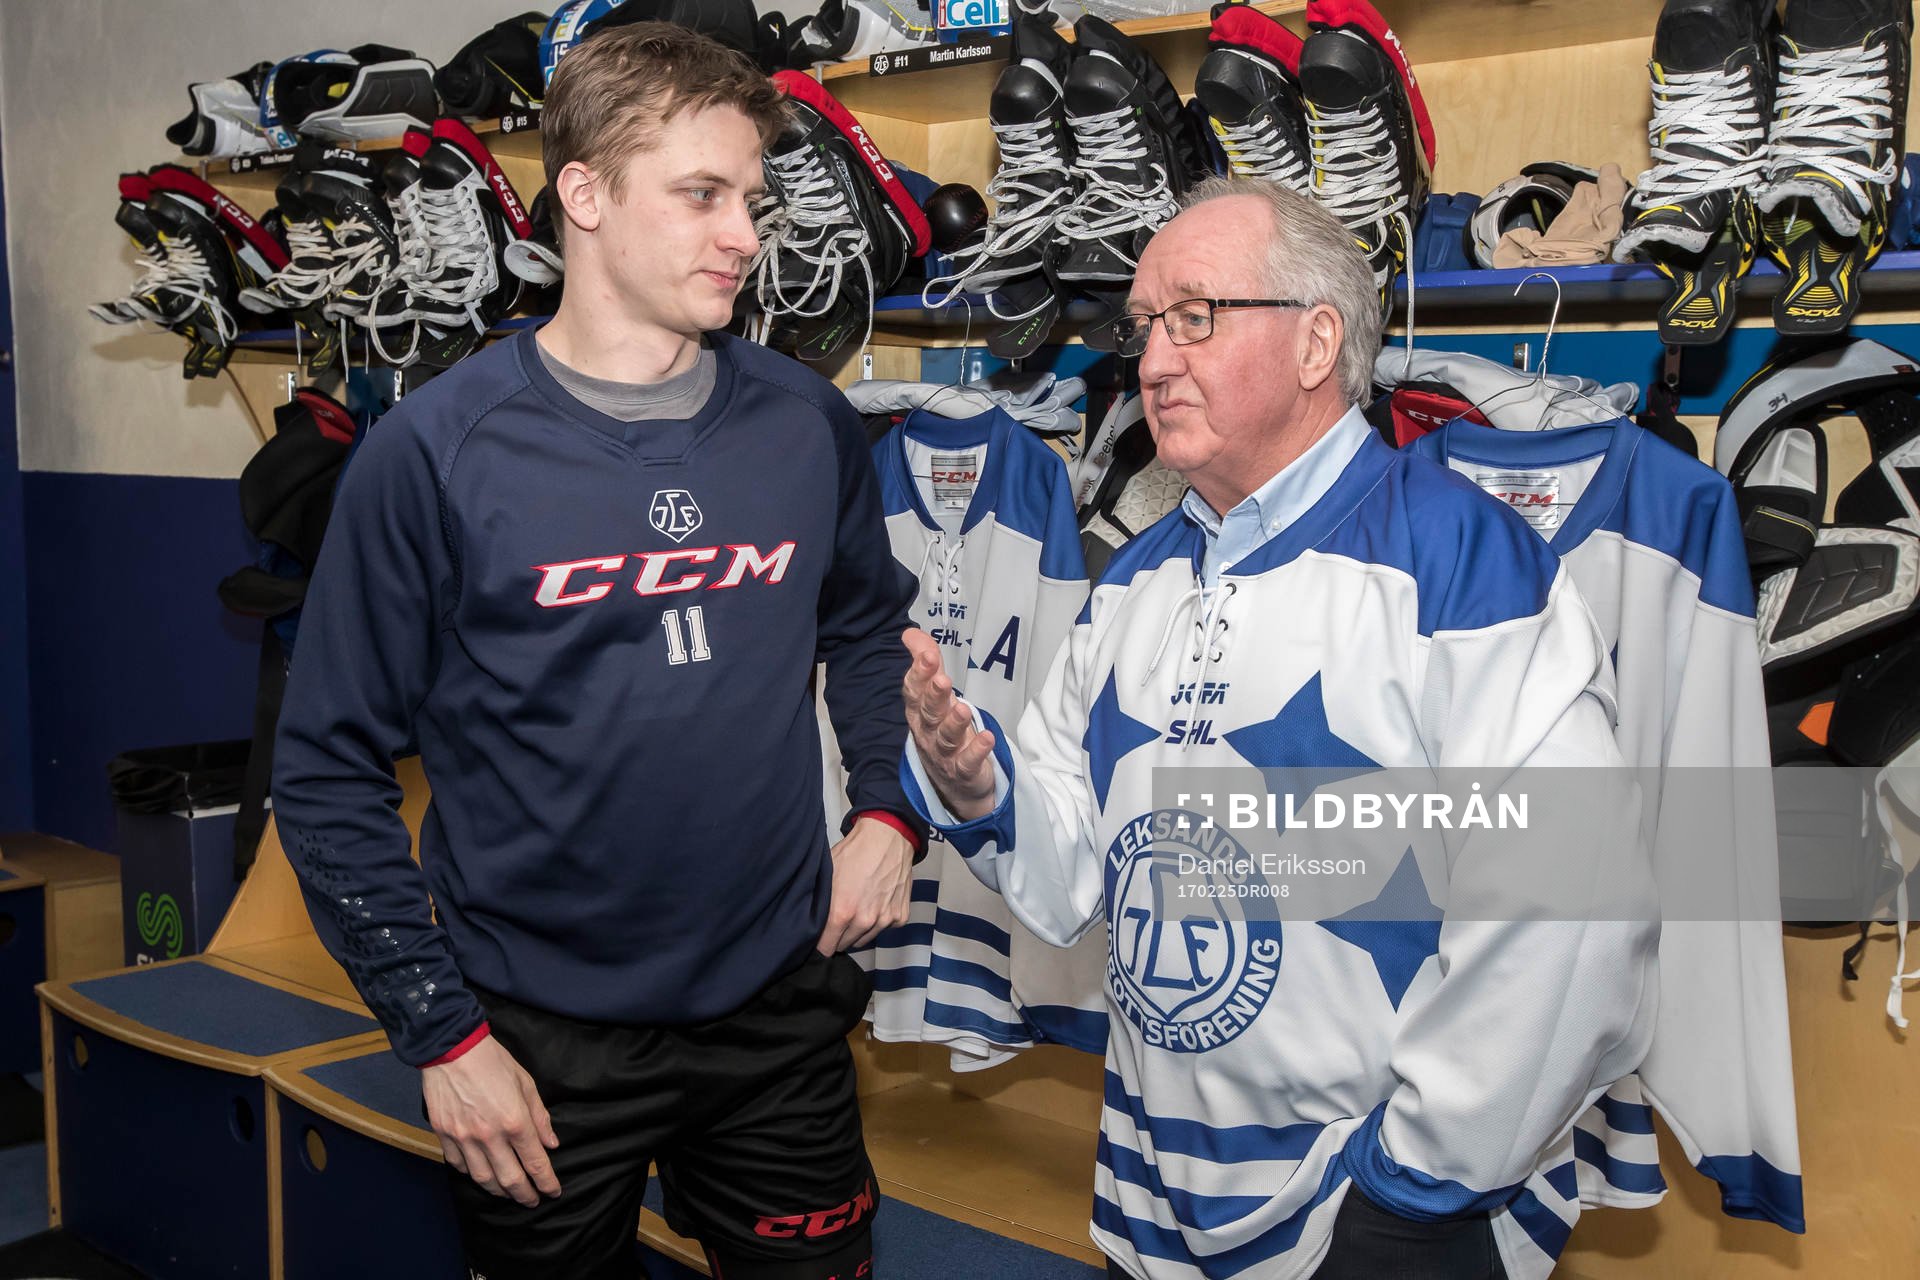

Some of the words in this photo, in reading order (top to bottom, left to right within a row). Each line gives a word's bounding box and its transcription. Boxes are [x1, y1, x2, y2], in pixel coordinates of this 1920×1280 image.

[894, 56, 909, 68] #11
[929, 51, 955, 63] Martin
[956, 45, 992, 59] Karlsson
[851, 125, 894, 183] CCM
[493, 174, 525, 224] CCM
[1668, 316, 1719, 330] TACKS
[1785, 304, 1844, 318] TACKS
[932, 471, 977, 483] CCM
[529, 541, 797, 608] CCM
[661, 606, 711, 665] 11
[930, 628, 962, 647] SHL
[980, 615, 1021, 682] A
[1165, 719, 1217, 745] SHL
[753, 1178, 874, 1238] CCM
